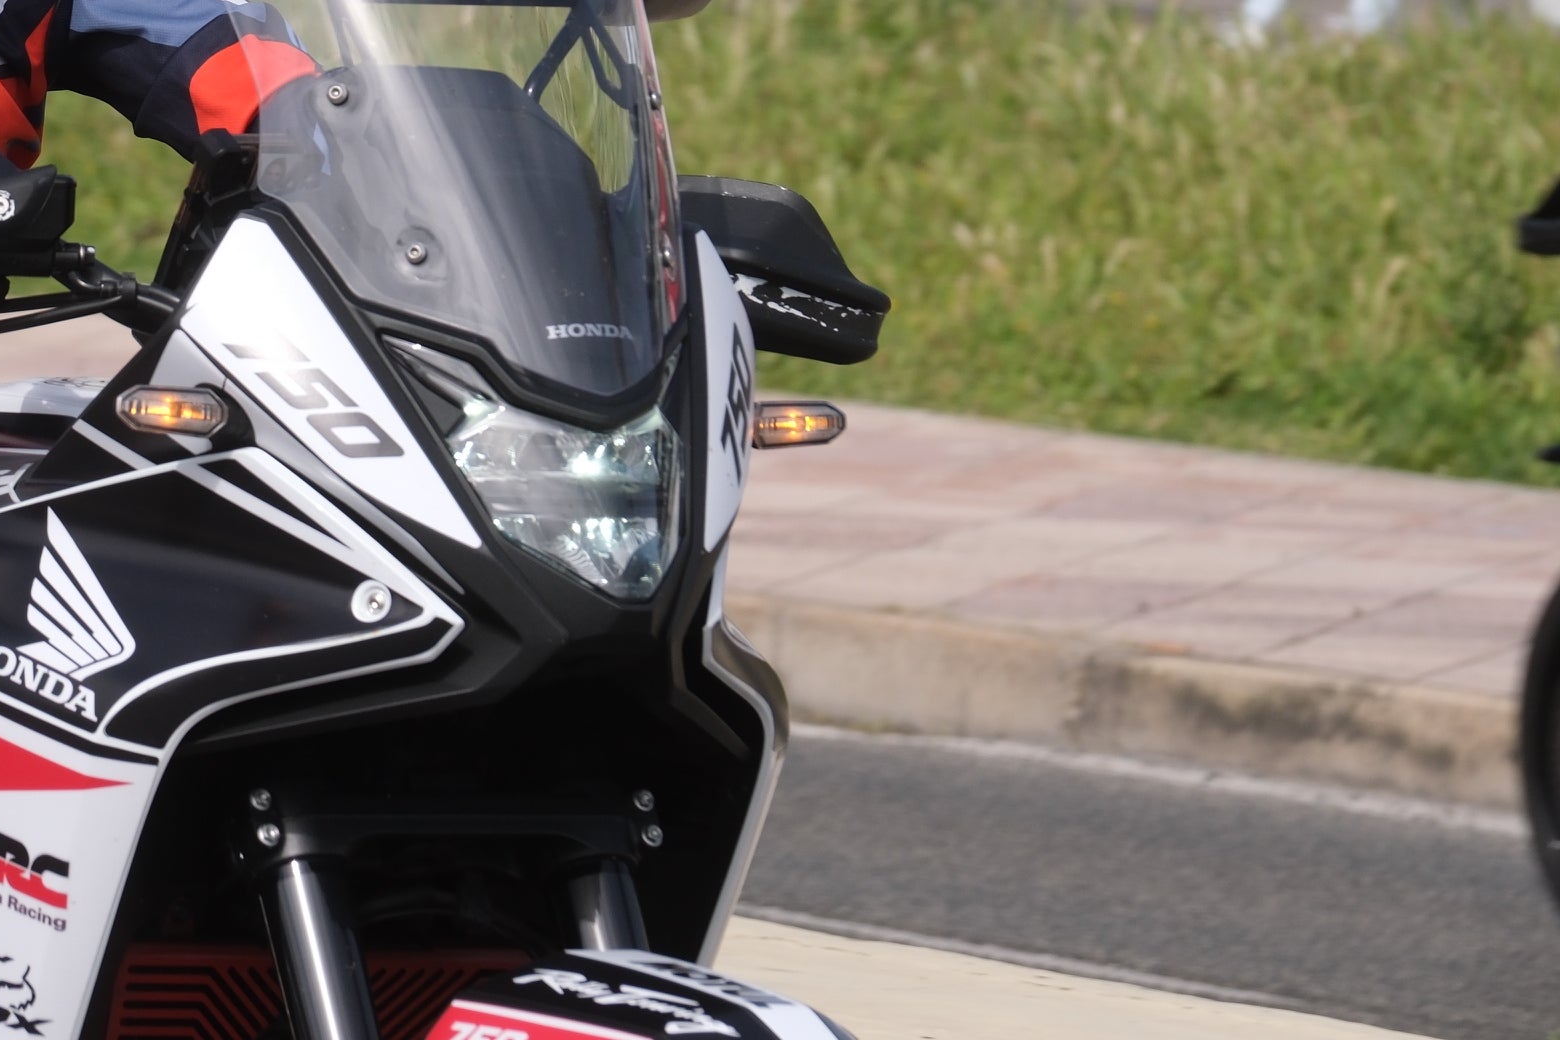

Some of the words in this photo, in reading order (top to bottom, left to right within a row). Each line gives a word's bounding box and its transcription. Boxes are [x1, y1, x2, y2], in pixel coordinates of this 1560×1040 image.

[545, 322, 634, 340] HONDA
[221, 326, 405, 459] 750
[720, 321, 752, 488] 750
[7, 894, 67, 932] Racing
